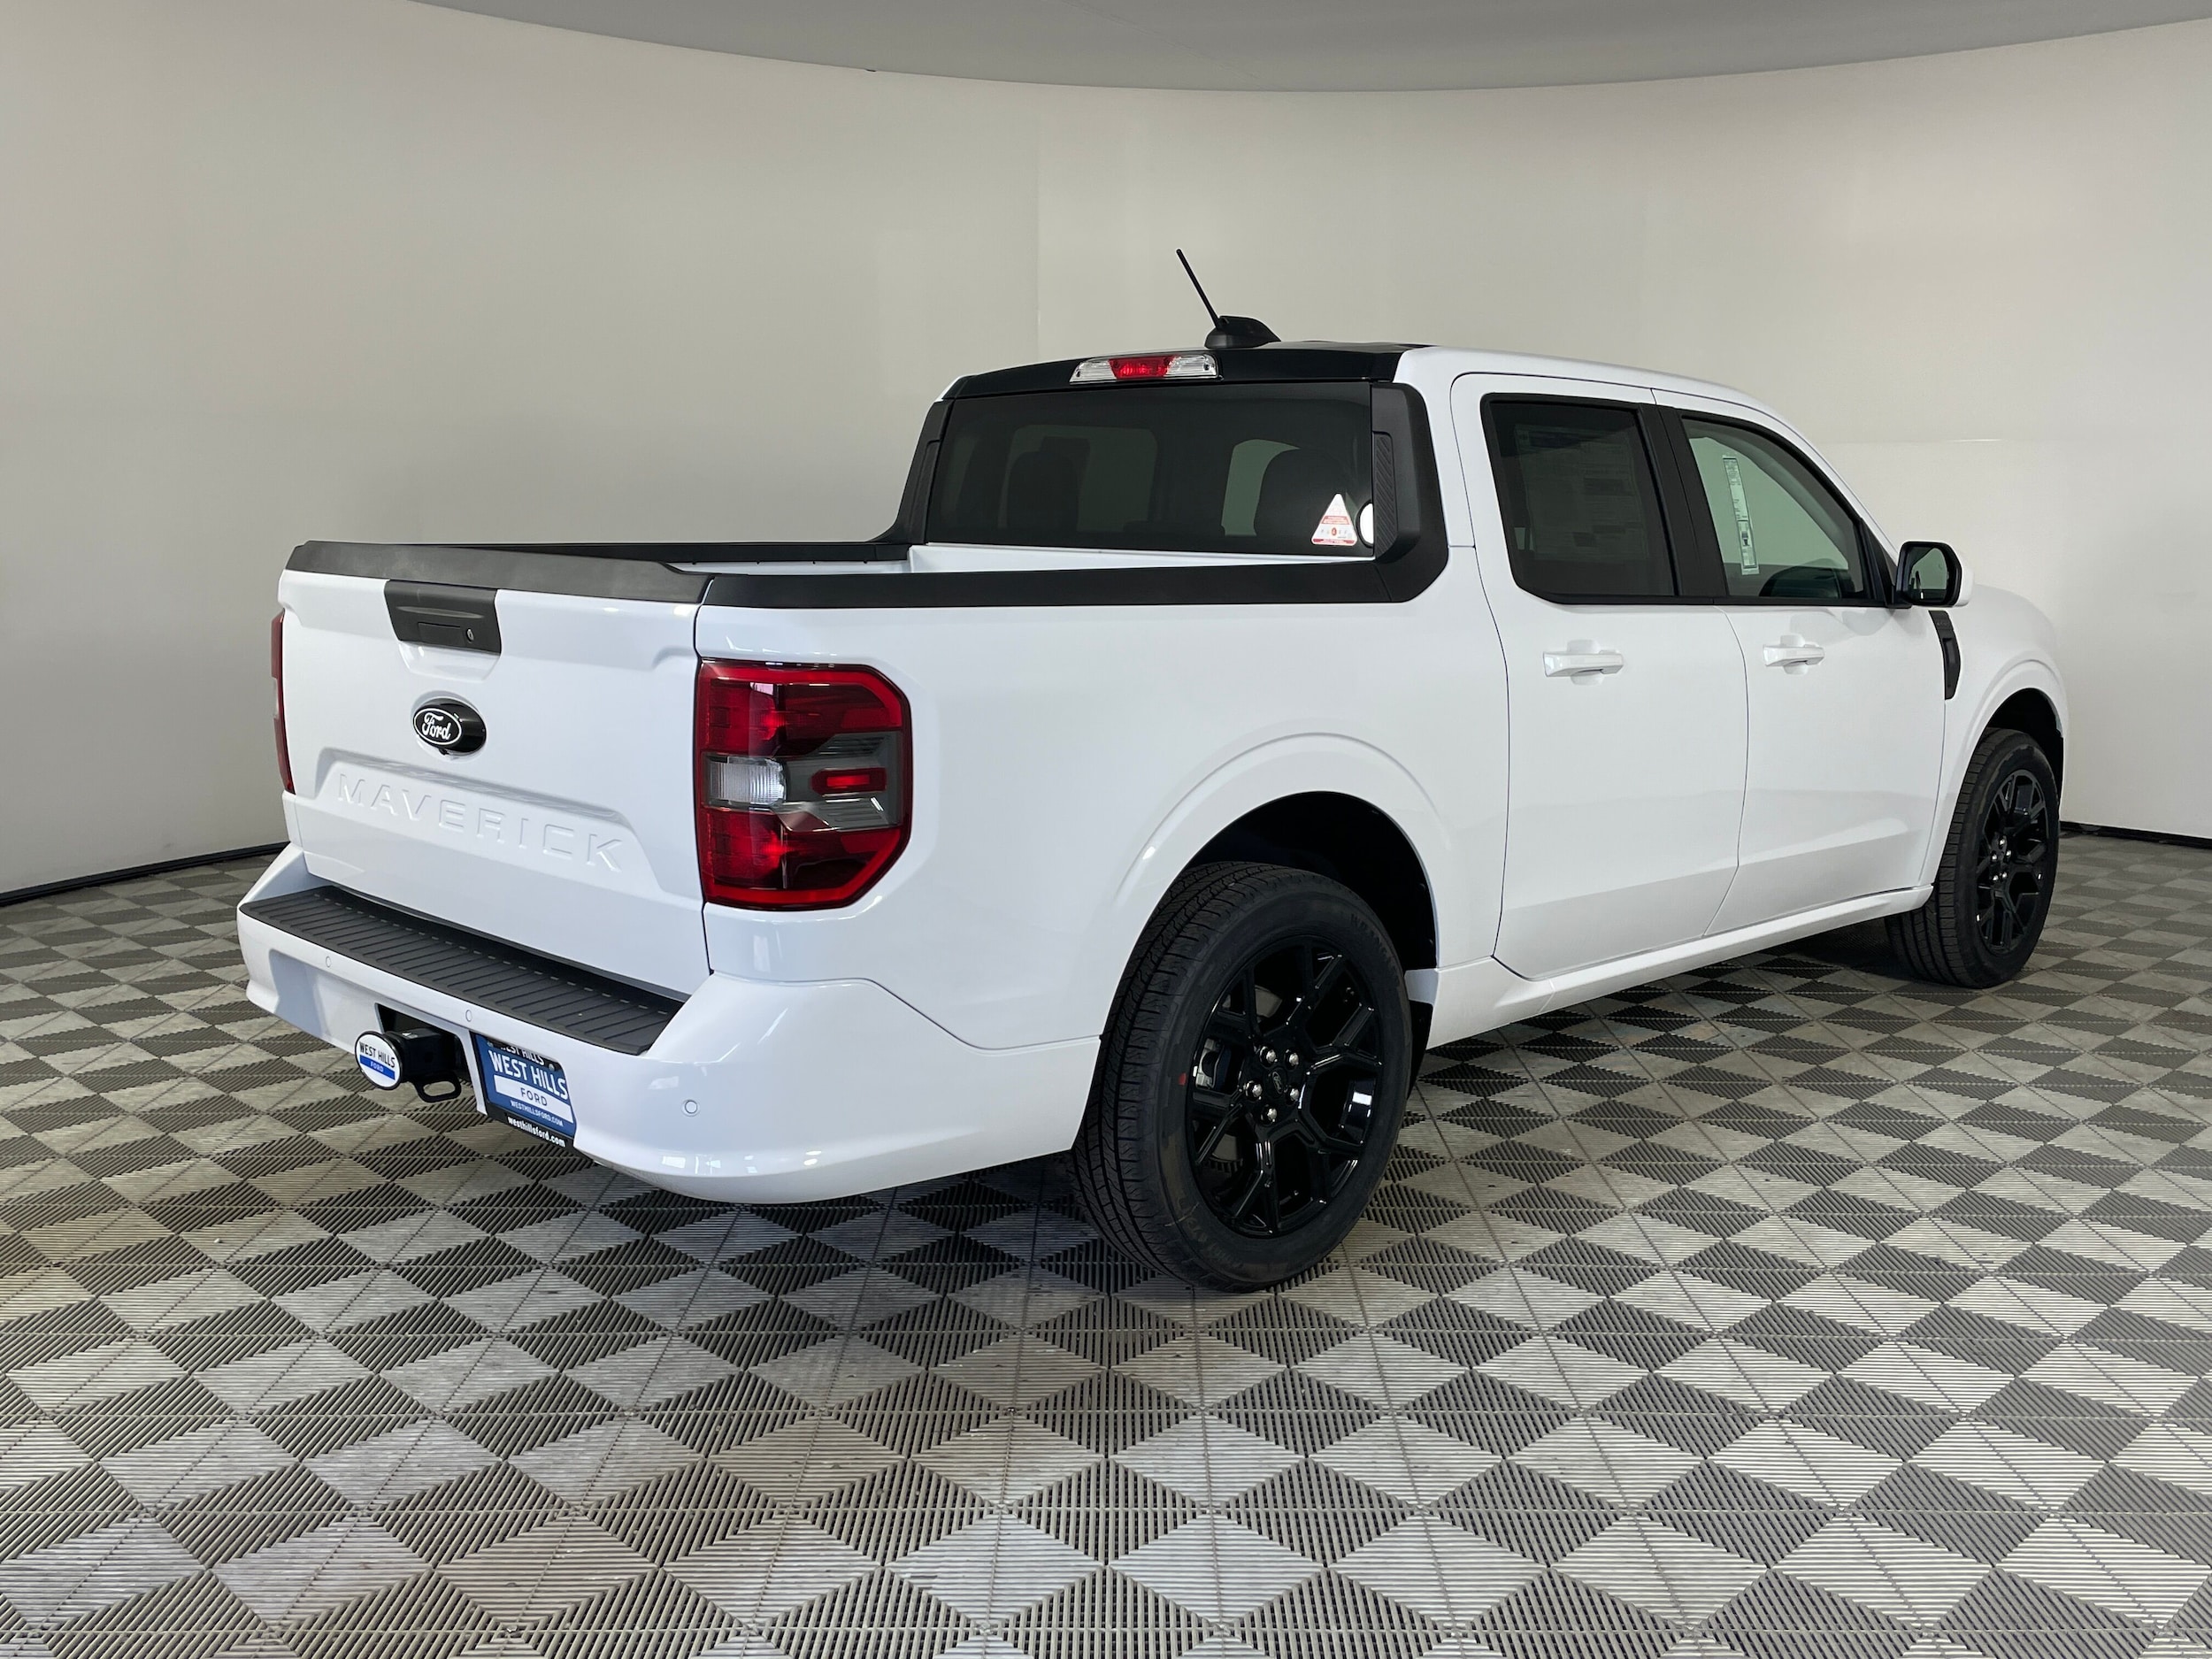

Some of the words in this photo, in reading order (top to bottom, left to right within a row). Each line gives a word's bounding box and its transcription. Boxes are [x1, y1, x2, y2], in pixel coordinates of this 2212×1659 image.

[422, 712, 452, 741] Ford
[337, 773, 623, 872] MAVERICK
[359, 1041, 376, 1057] WEST
[378, 1050, 396, 1068] HILLS
[488, 1049, 527, 1080] WEST
[530, 1065, 568, 1100] HILLS
[520, 1087, 548, 1107] FORD
[510, 1100, 565, 1127] WESTHILLSFORD.COM
[507, 1117, 566, 1148] westhillsford.com
